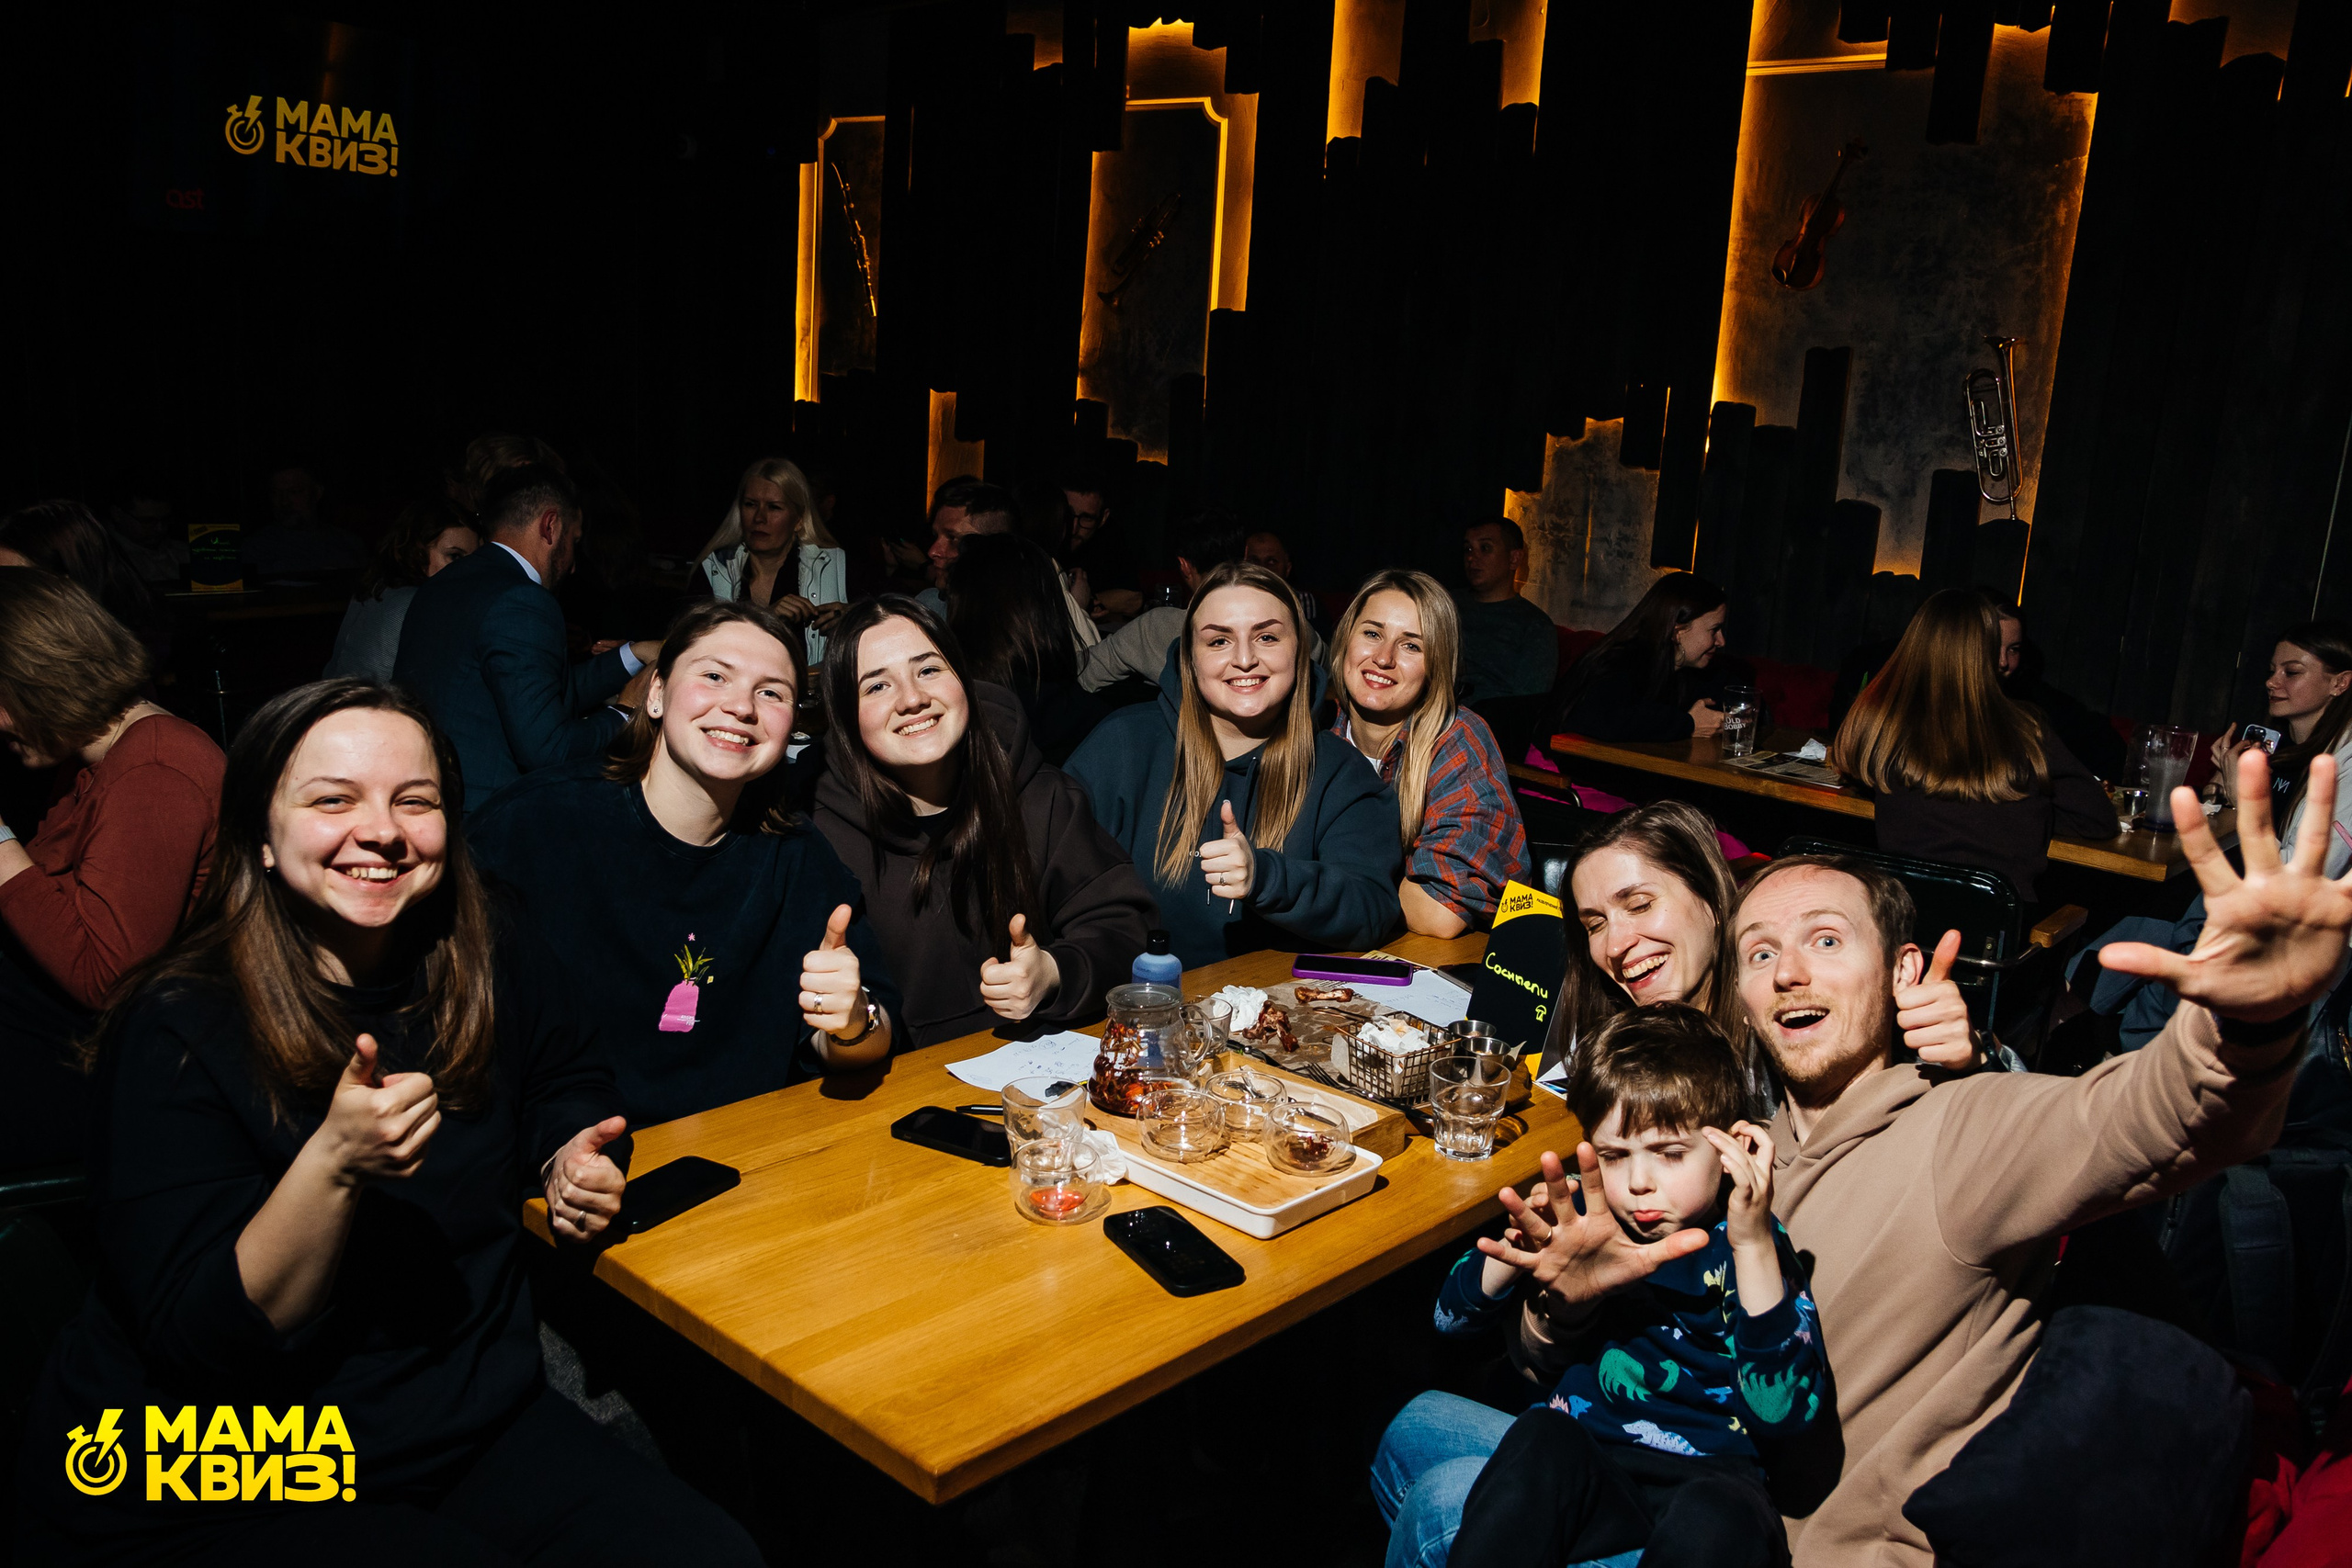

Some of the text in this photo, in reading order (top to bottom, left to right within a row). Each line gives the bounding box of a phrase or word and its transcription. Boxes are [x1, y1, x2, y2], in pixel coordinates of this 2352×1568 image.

[276, 96, 399, 146] МАМА
[275, 130, 400, 178] КВИЗ!
[1510, 893, 1533, 905] МАМА
[1510, 899, 1533, 913] КВИЗ!
